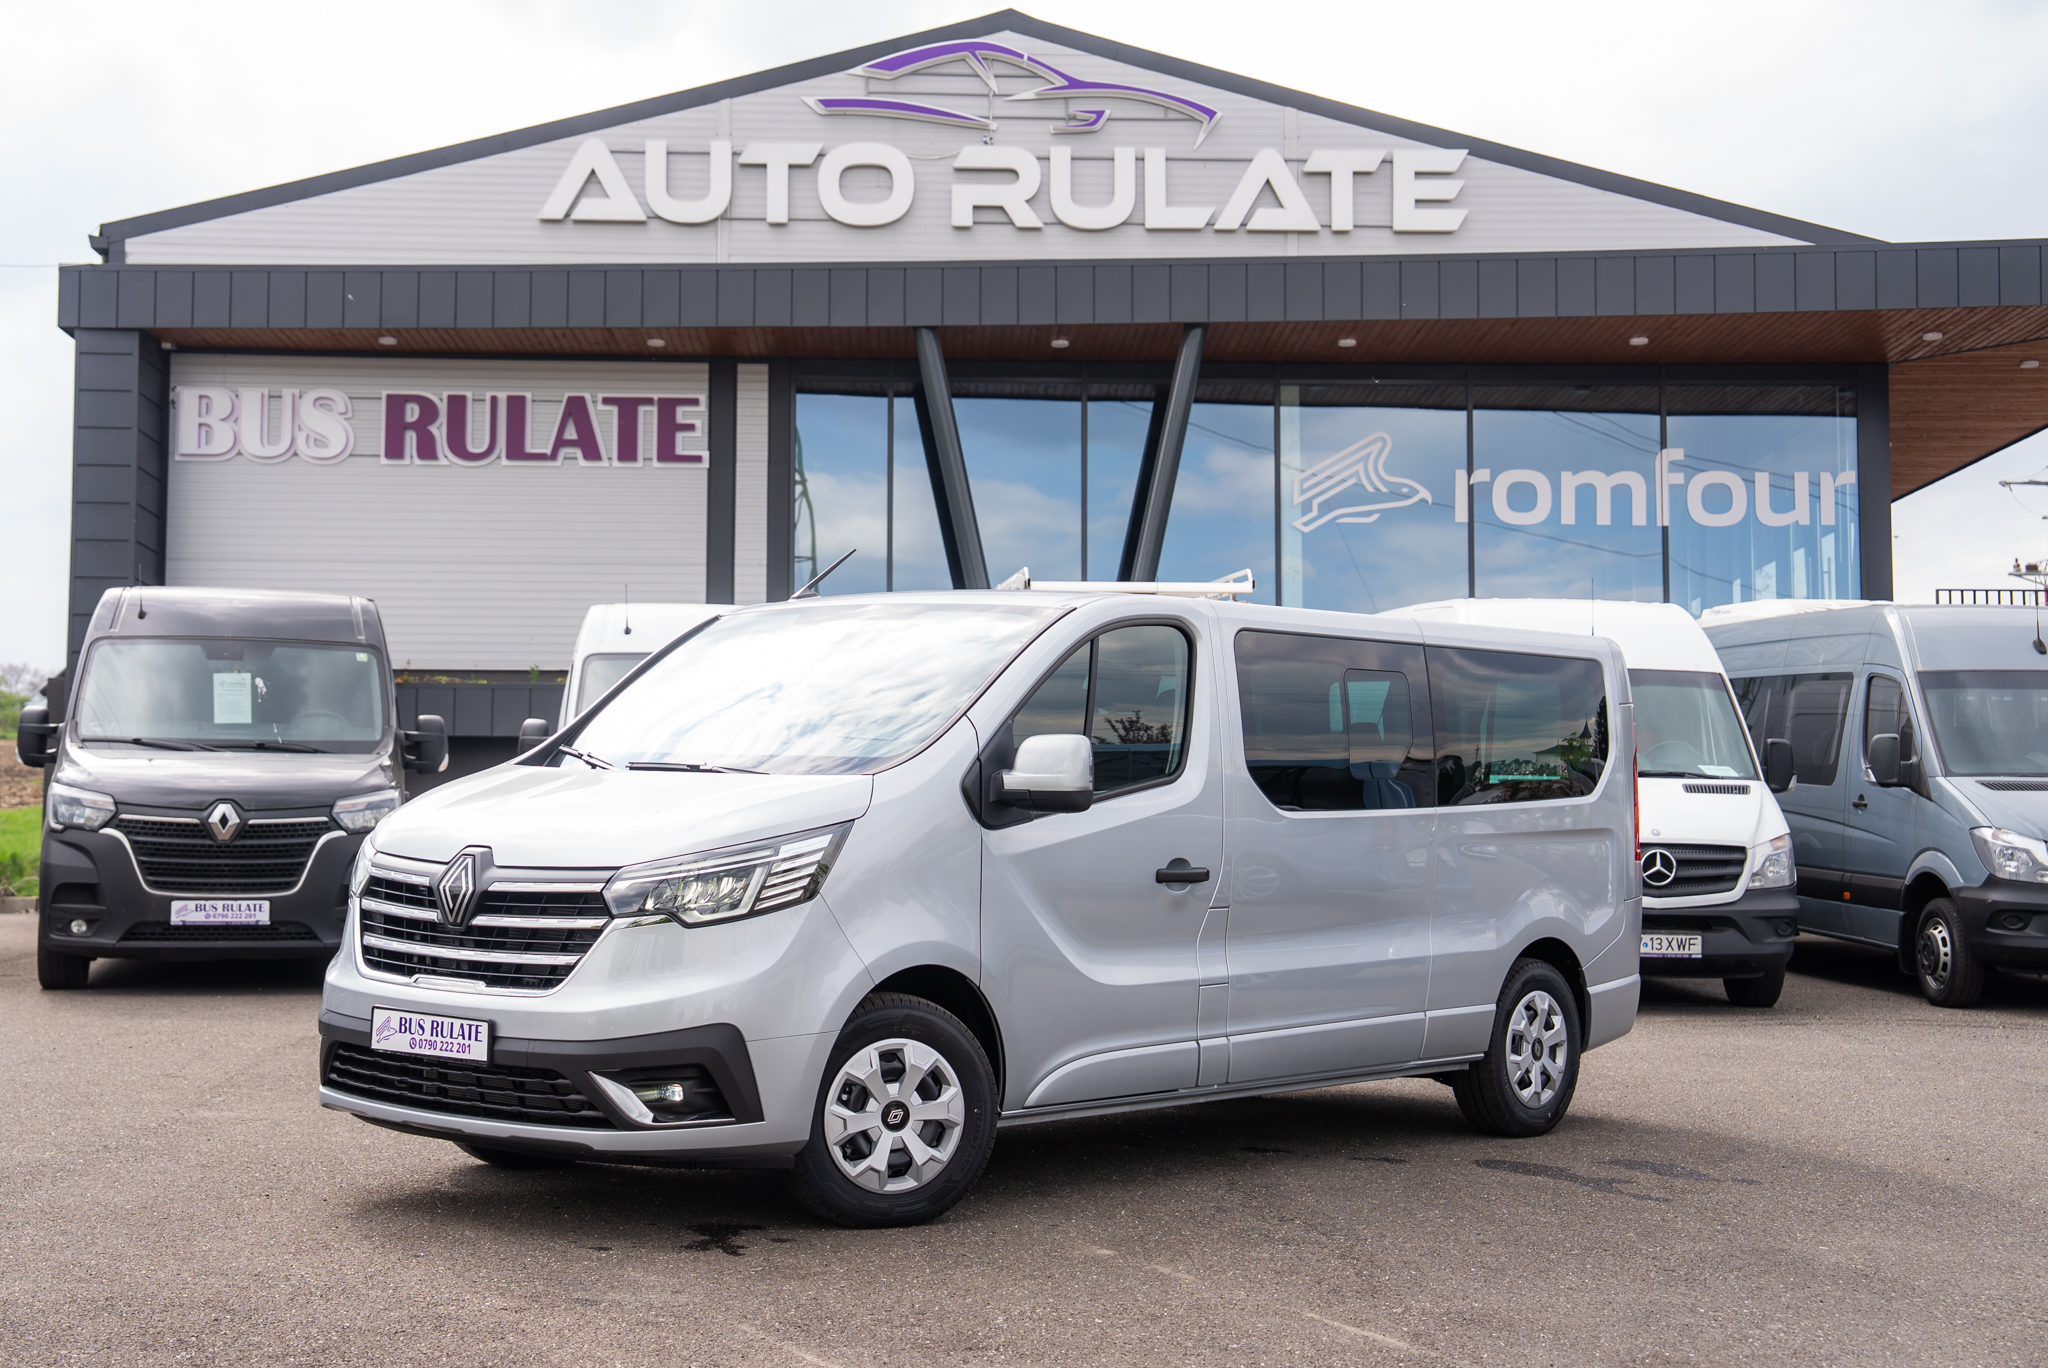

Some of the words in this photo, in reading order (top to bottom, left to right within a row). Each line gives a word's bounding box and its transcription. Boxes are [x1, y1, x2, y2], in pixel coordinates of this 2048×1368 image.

[538, 137, 915, 228] AUTO
[950, 144, 1470, 233] RULATE
[174, 386, 355, 465] BUS
[381, 390, 709, 469] RULATE
[1454, 447, 1856, 527] romfour
[195, 903, 218, 912] BUS
[222, 903, 265, 912] RULATE
[399, 1016, 426, 1036] BUS
[430, 1020, 483, 1042] RULATE
[418, 1038, 438, 1051] 0790
[439, 1041, 454, 1053] 222
[456, 1042, 471, 1054] 201
